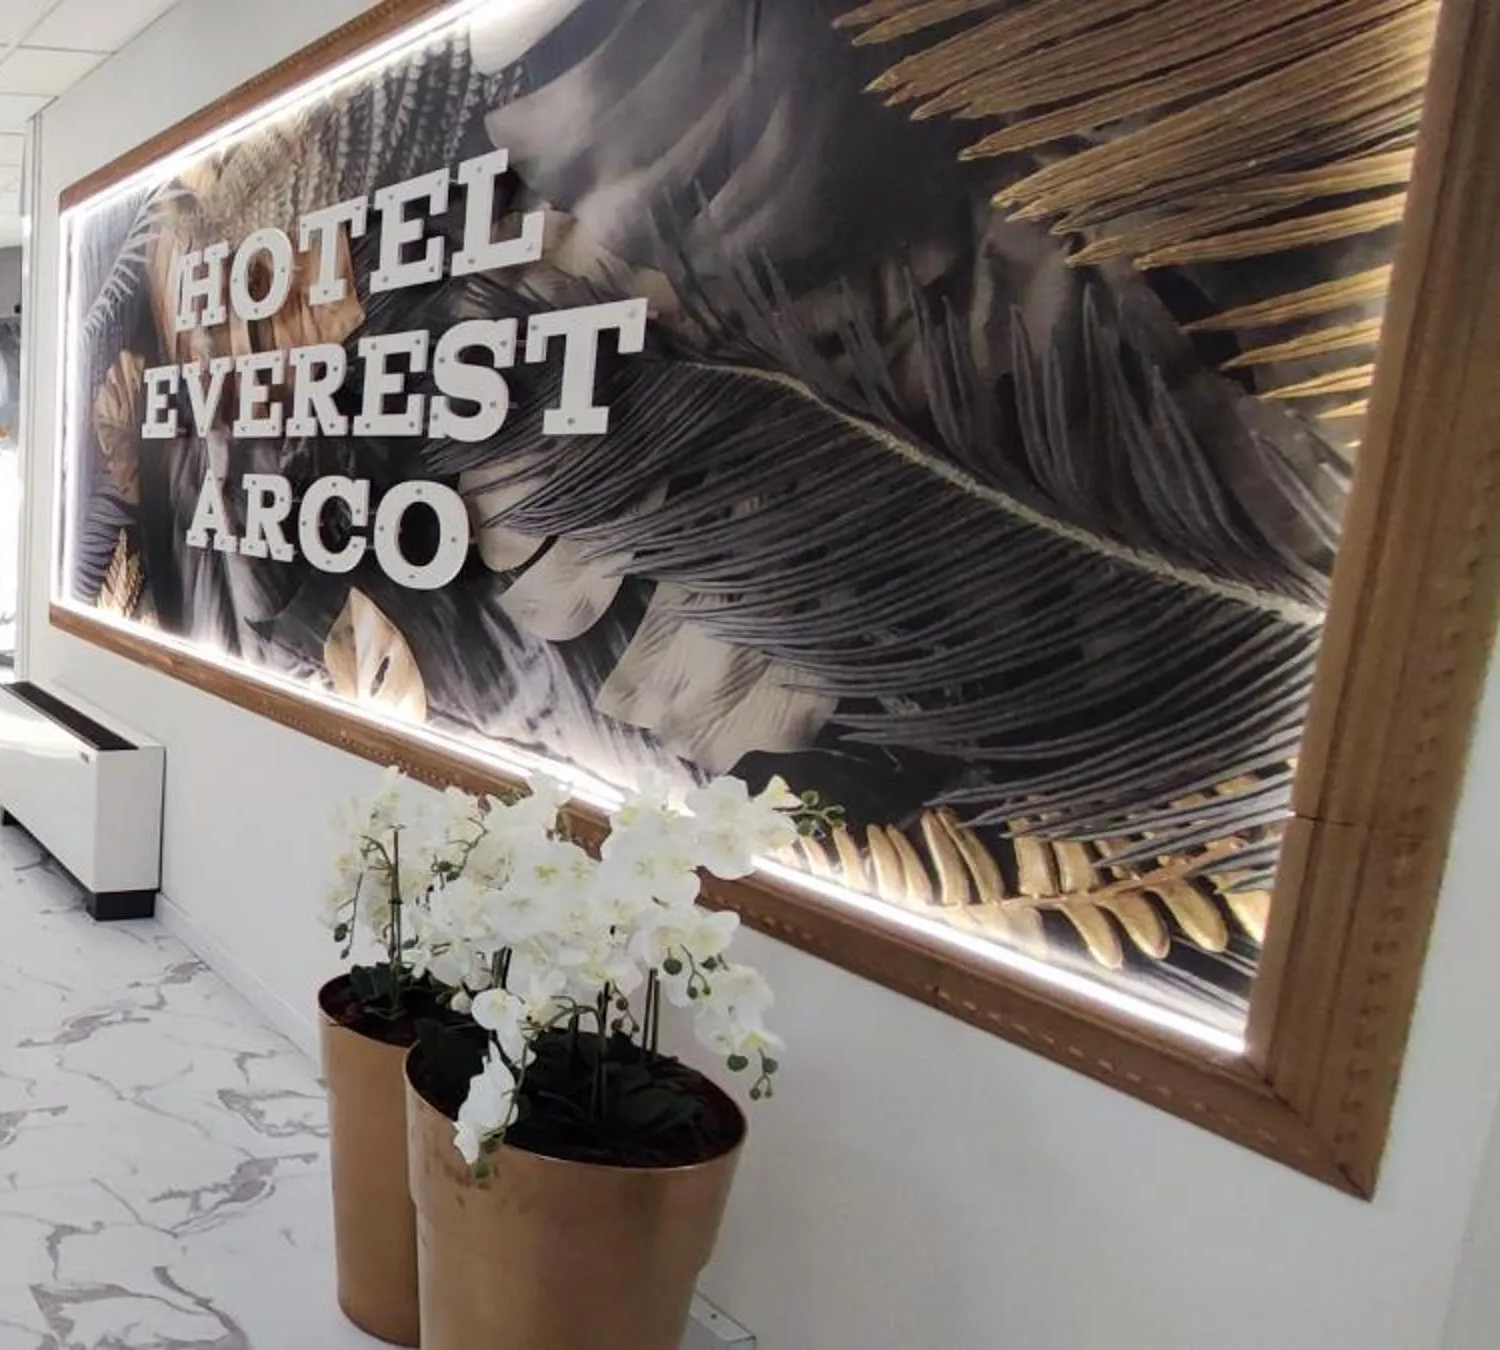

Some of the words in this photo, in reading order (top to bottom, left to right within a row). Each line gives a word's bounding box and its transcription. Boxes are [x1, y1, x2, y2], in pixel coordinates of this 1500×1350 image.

[175, 148, 544, 333] HOTEL
[141, 297, 648, 442] EVEREST
[186, 470, 470, 591] ARCO
